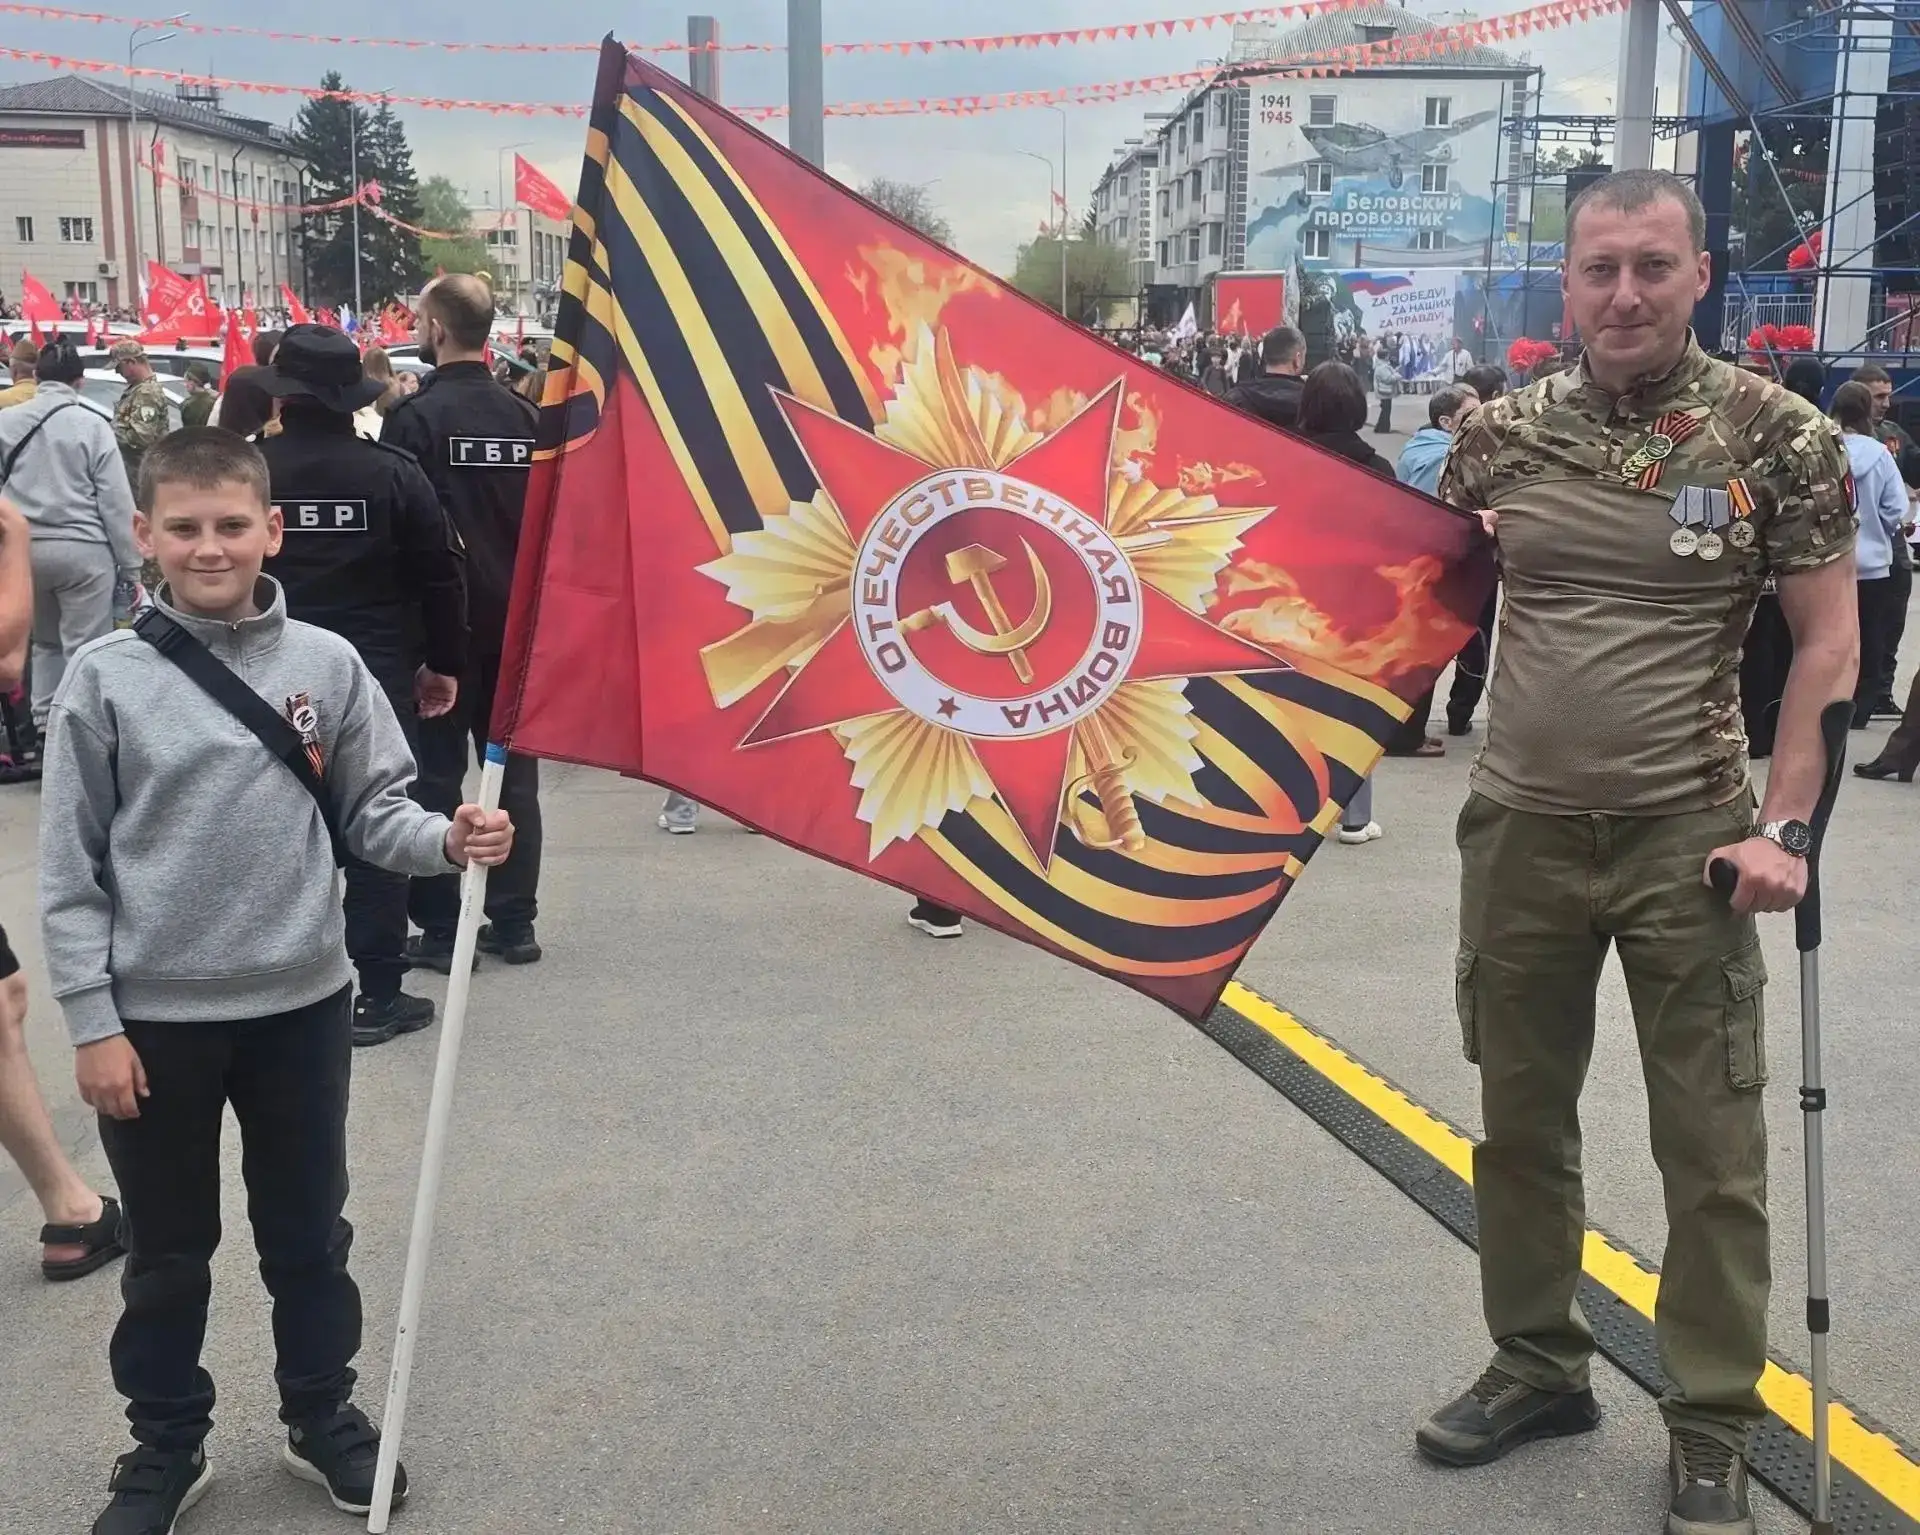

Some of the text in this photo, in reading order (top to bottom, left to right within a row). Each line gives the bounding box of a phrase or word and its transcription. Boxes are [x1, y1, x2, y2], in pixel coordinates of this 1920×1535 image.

[1260, 94, 1291, 108] 1941
[1259, 110, 1293, 124] 1945
[1346, 191, 1463, 211] Беловский
[1314, 210, 1443, 230] паровозник
[1391, 286, 1446, 304] ПОБЕДУ!
[460, 442, 528, 463] ГБР
[863, 476, 1131, 729] ОТЕЧЕСТВЕННАЯ ВОЙНА
